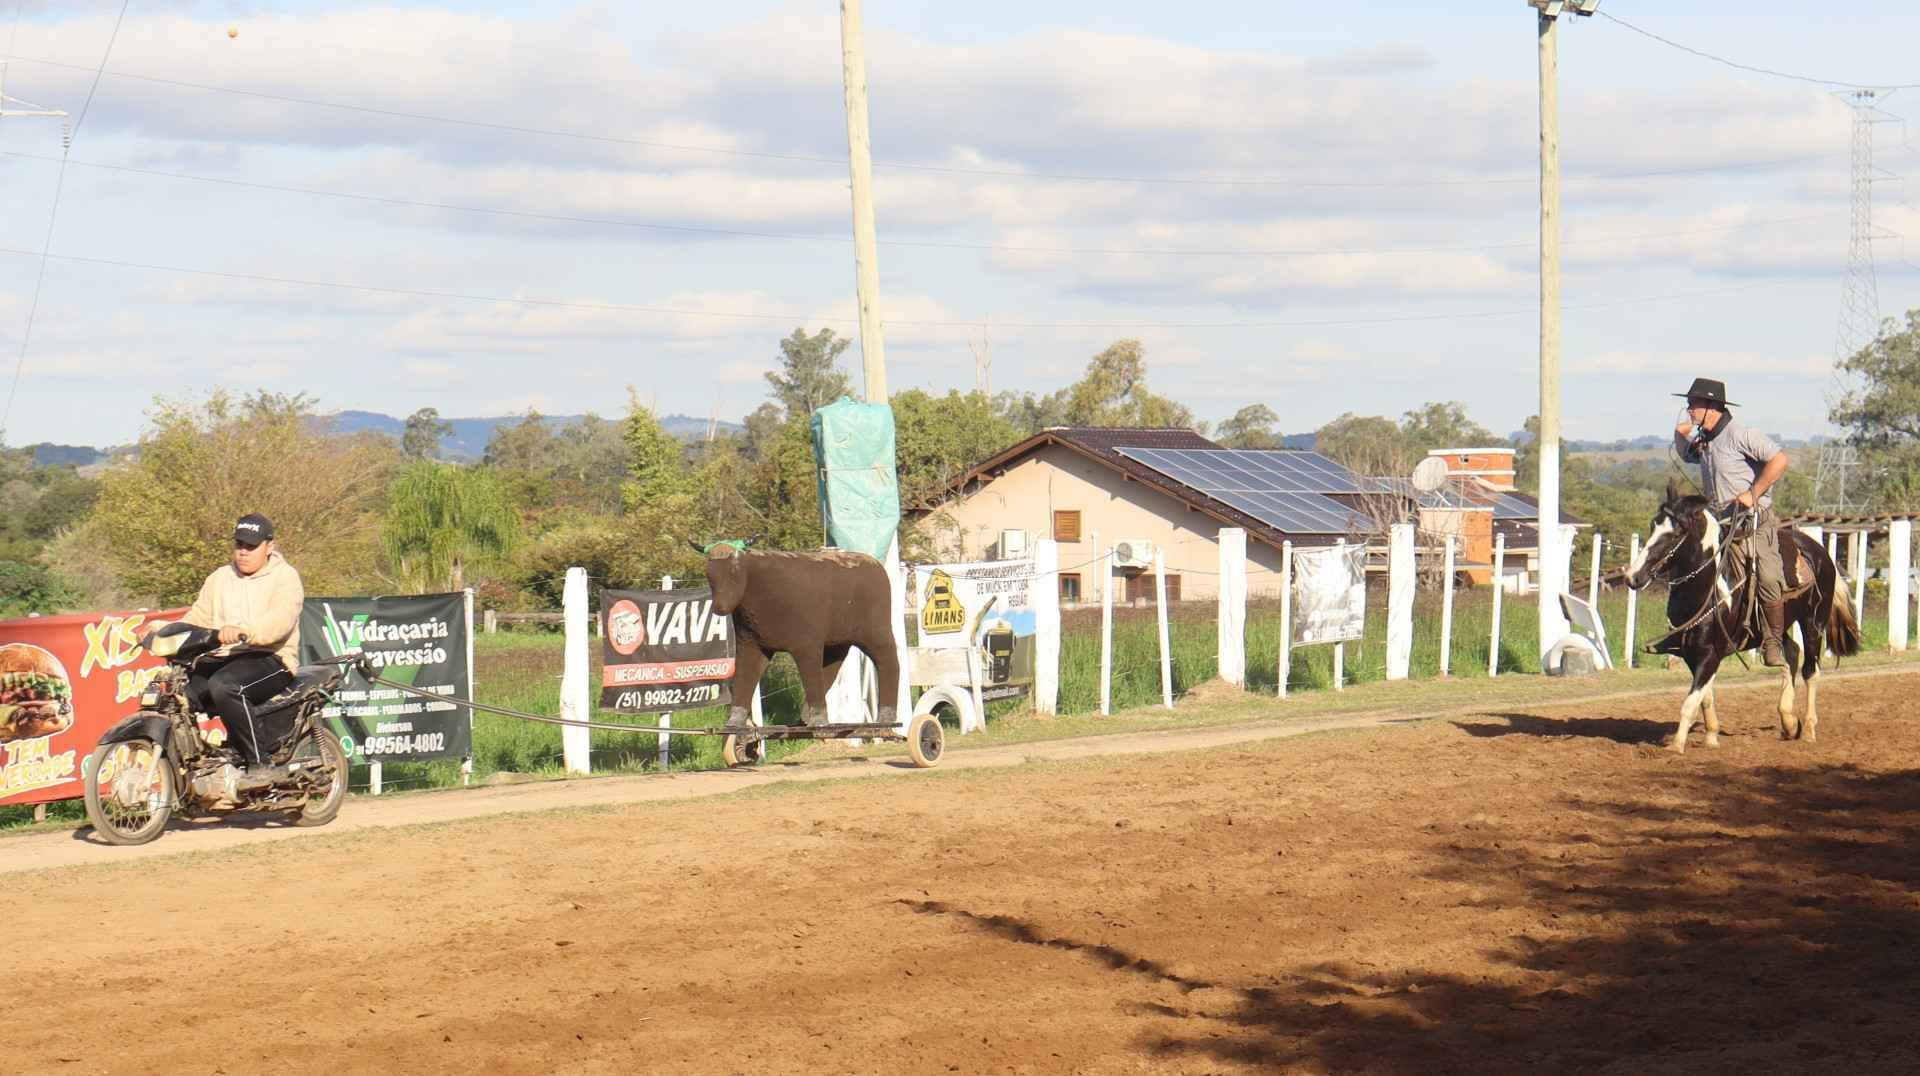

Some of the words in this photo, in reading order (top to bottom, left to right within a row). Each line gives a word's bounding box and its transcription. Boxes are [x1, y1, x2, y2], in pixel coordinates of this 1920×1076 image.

[924, 609, 964, 626] LIMANS
[339, 617, 449, 645] Vidraçaria
[80, 615, 146, 678] XIS
[615, 691, 641, 709] (51)
[5, 737, 50, 765] TEM
[365, 732, 445, 755] 99564-4802
